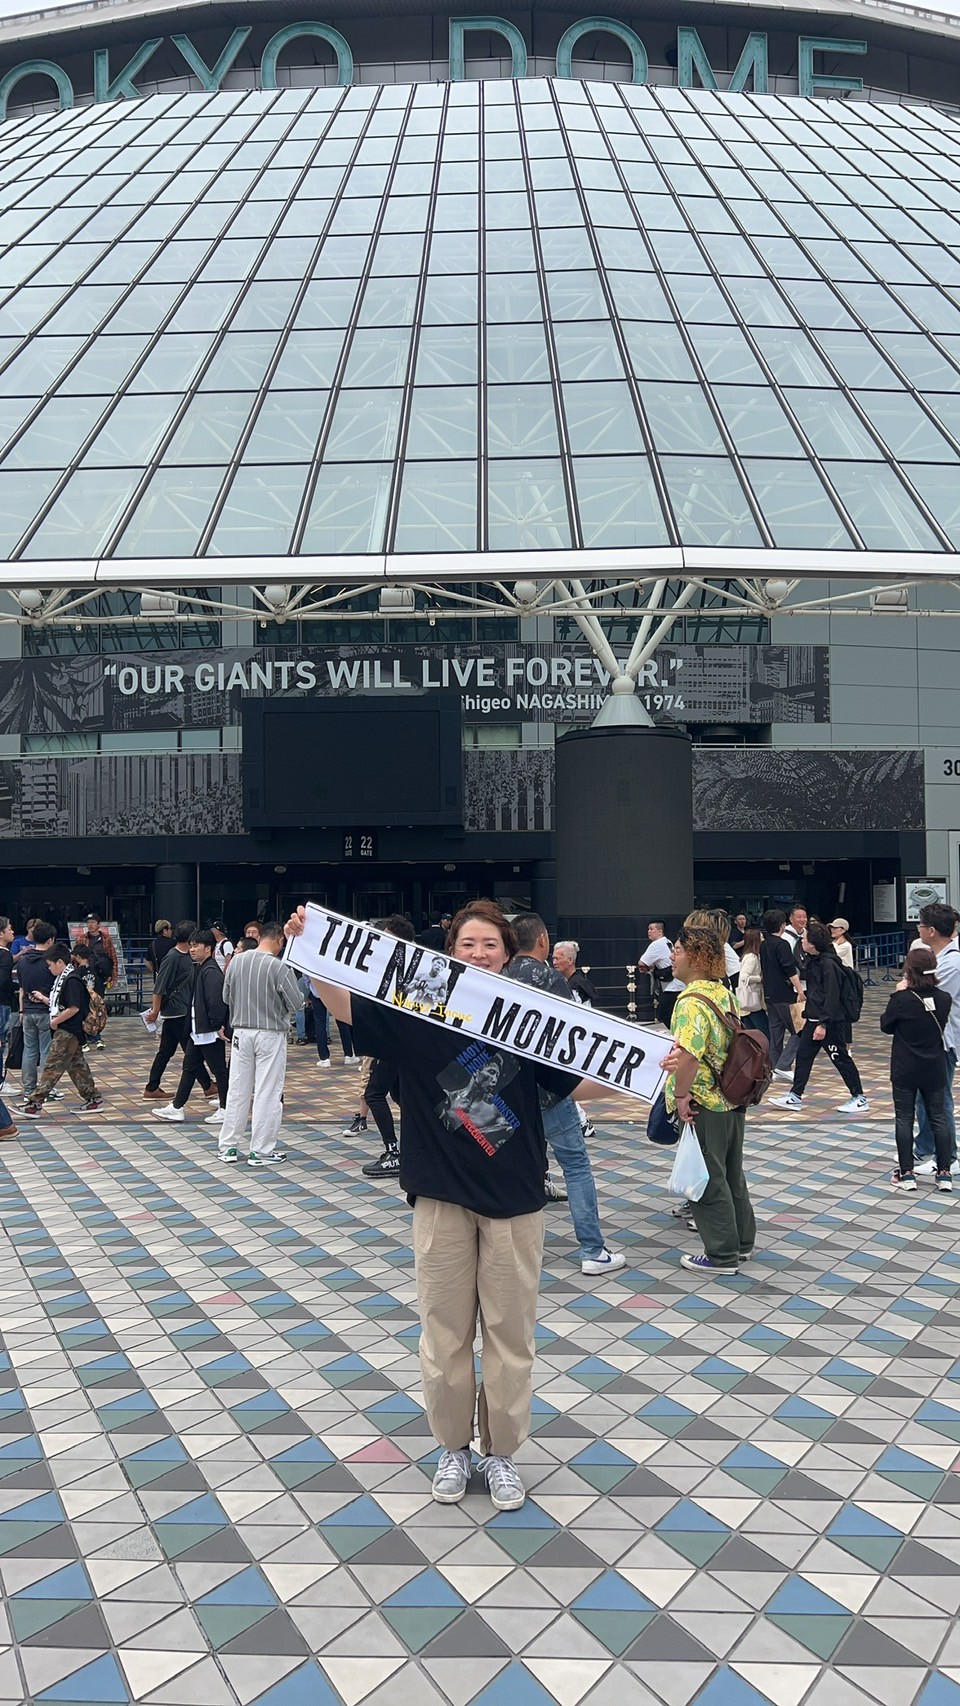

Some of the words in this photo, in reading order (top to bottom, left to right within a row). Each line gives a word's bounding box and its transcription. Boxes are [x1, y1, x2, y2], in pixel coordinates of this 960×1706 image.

[0, 21, 354, 119] OKYO
[448, 15, 868, 98] DOME
[194, 661, 317, 691] GIANTS
[326, 659, 412, 689] WILL
[422, 658, 495, 688] LIVE
[461, 694, 511, 714] higeo
[643, 695, 685, 710] 1974
[360, 836, 373, 849] 22
[319, 916, 381, 973] THE
[481, 996, 645, 1089] MONSTER
[456, 1040, 486, 1066] NAOYA
[490, 1093, 520, 1130] MONSTER
